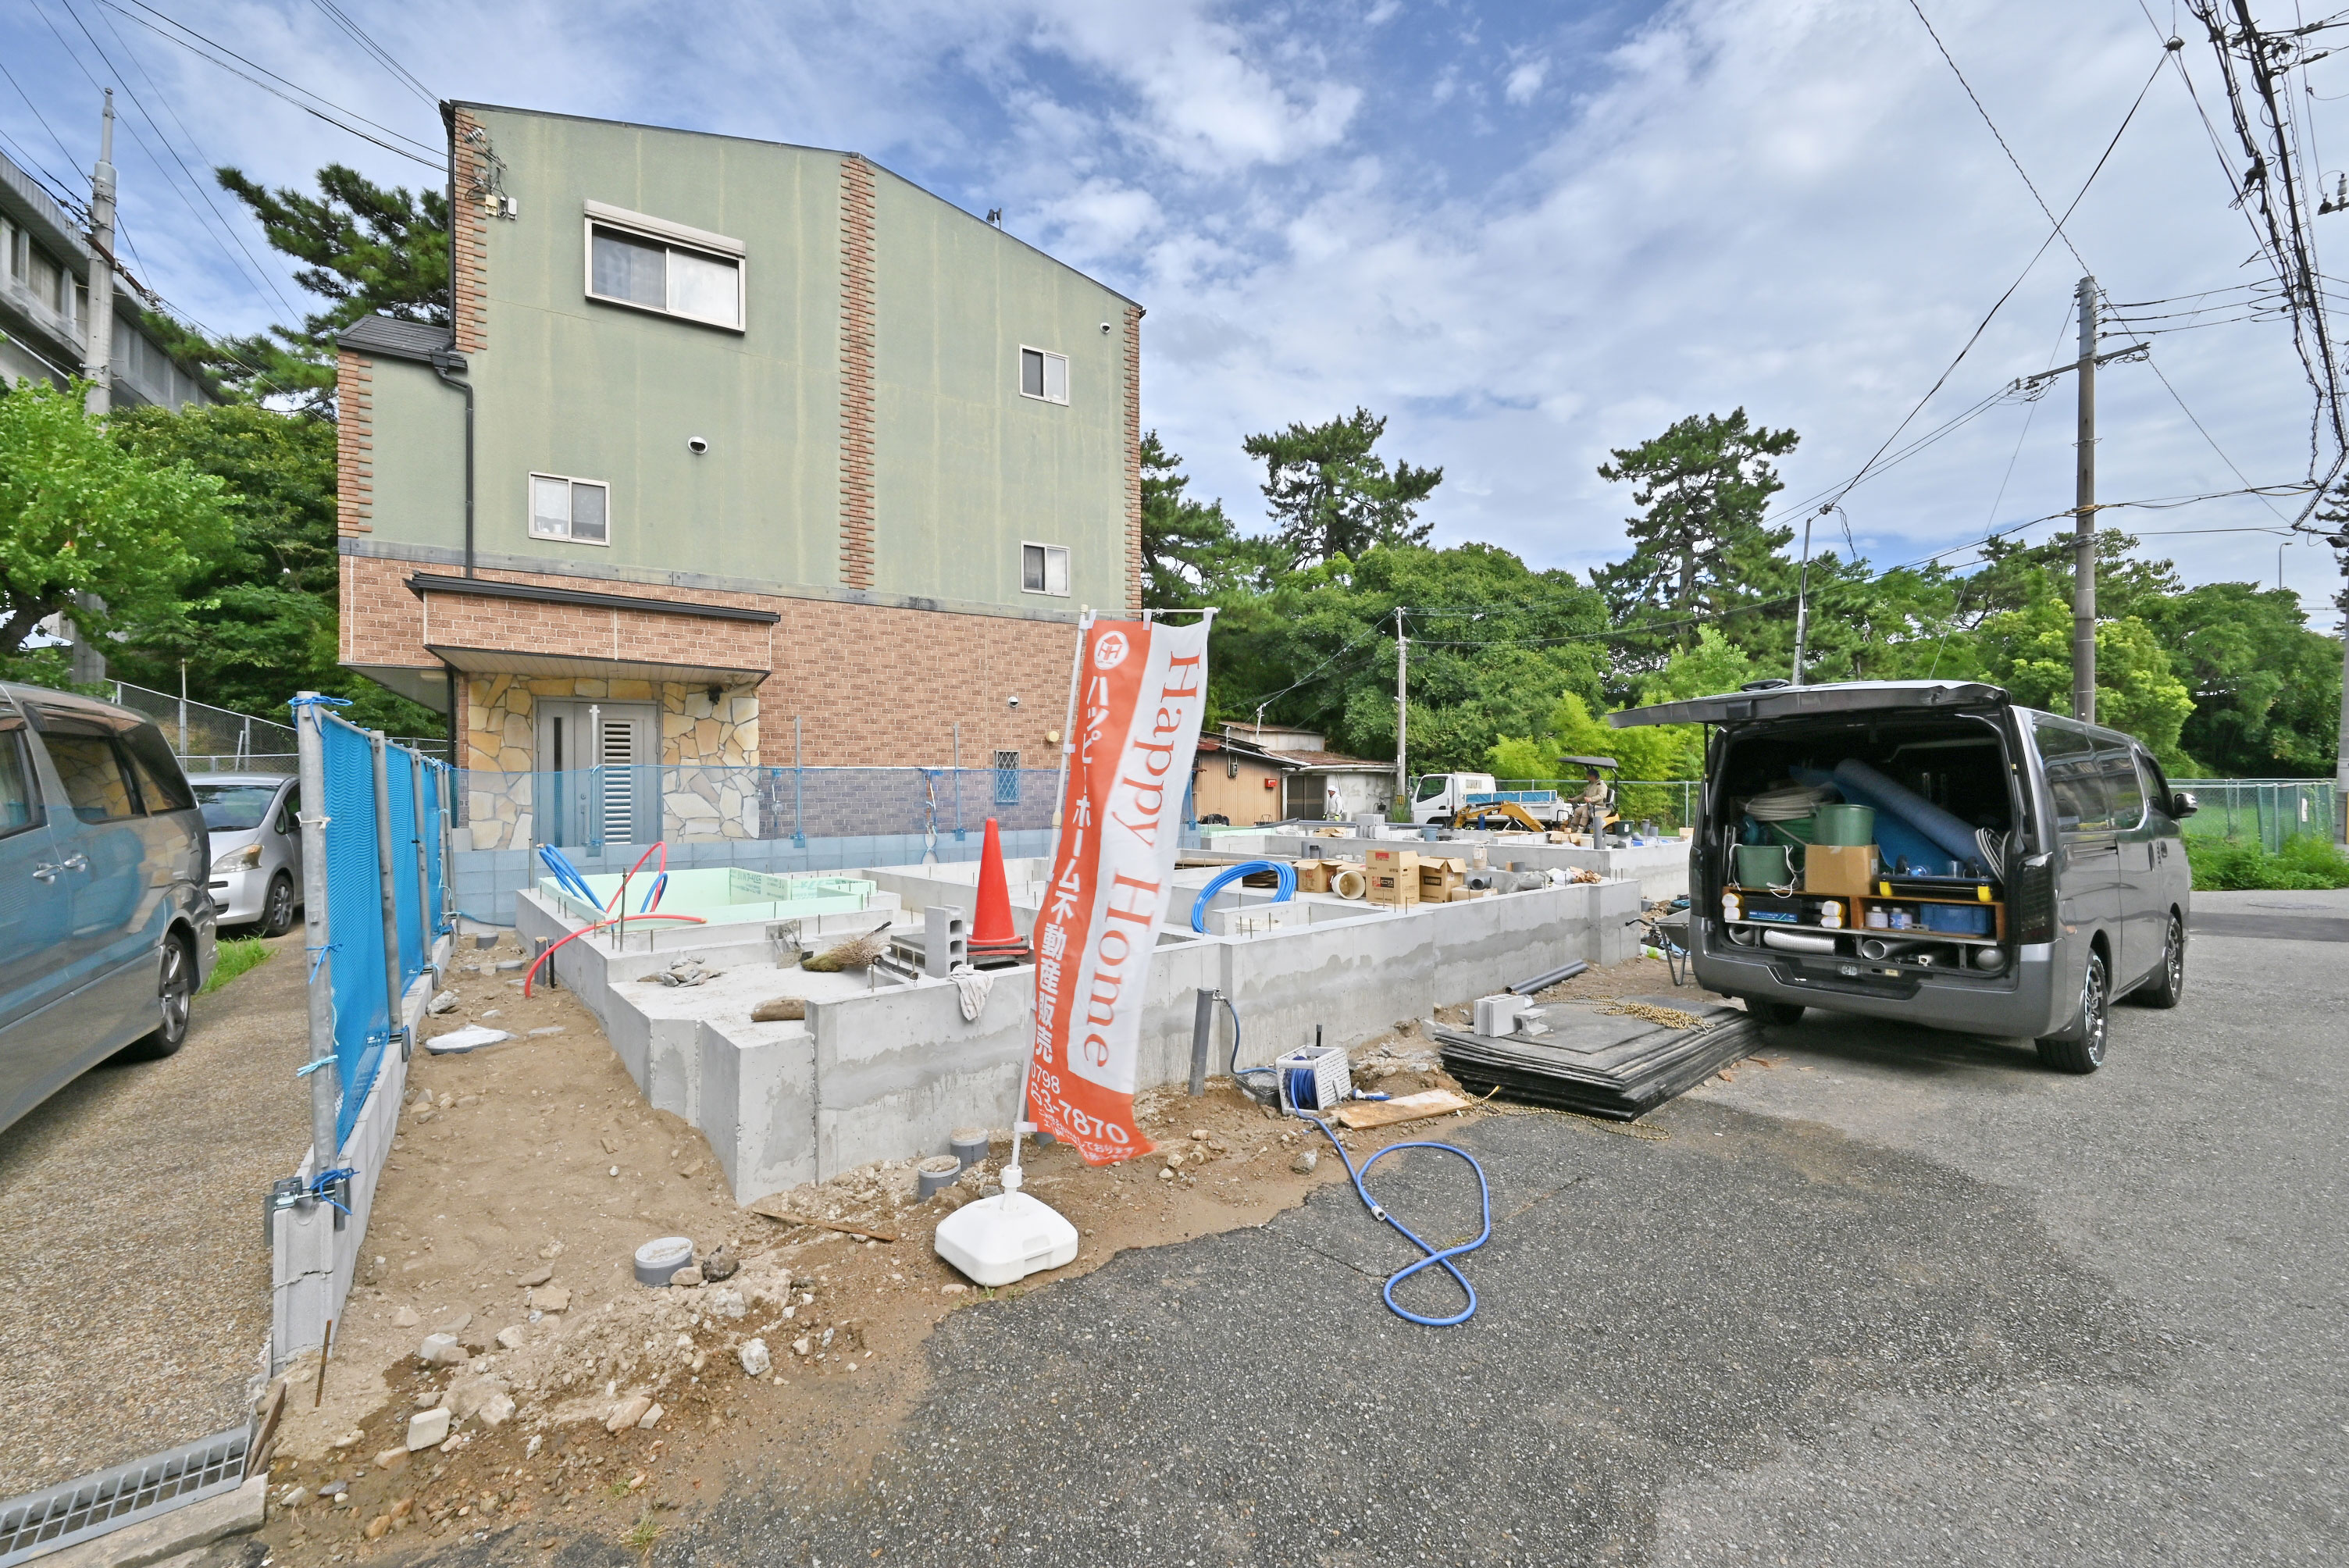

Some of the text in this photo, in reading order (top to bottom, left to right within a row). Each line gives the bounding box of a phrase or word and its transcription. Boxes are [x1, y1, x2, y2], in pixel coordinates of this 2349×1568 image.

[1112, 650, 1202, 849] Happy
[1084, 868, 1162, 1067] Home
[1031, 1061, 1060, 1094] 0798
[1031, 1081, 1130, 1144] 63-7870
